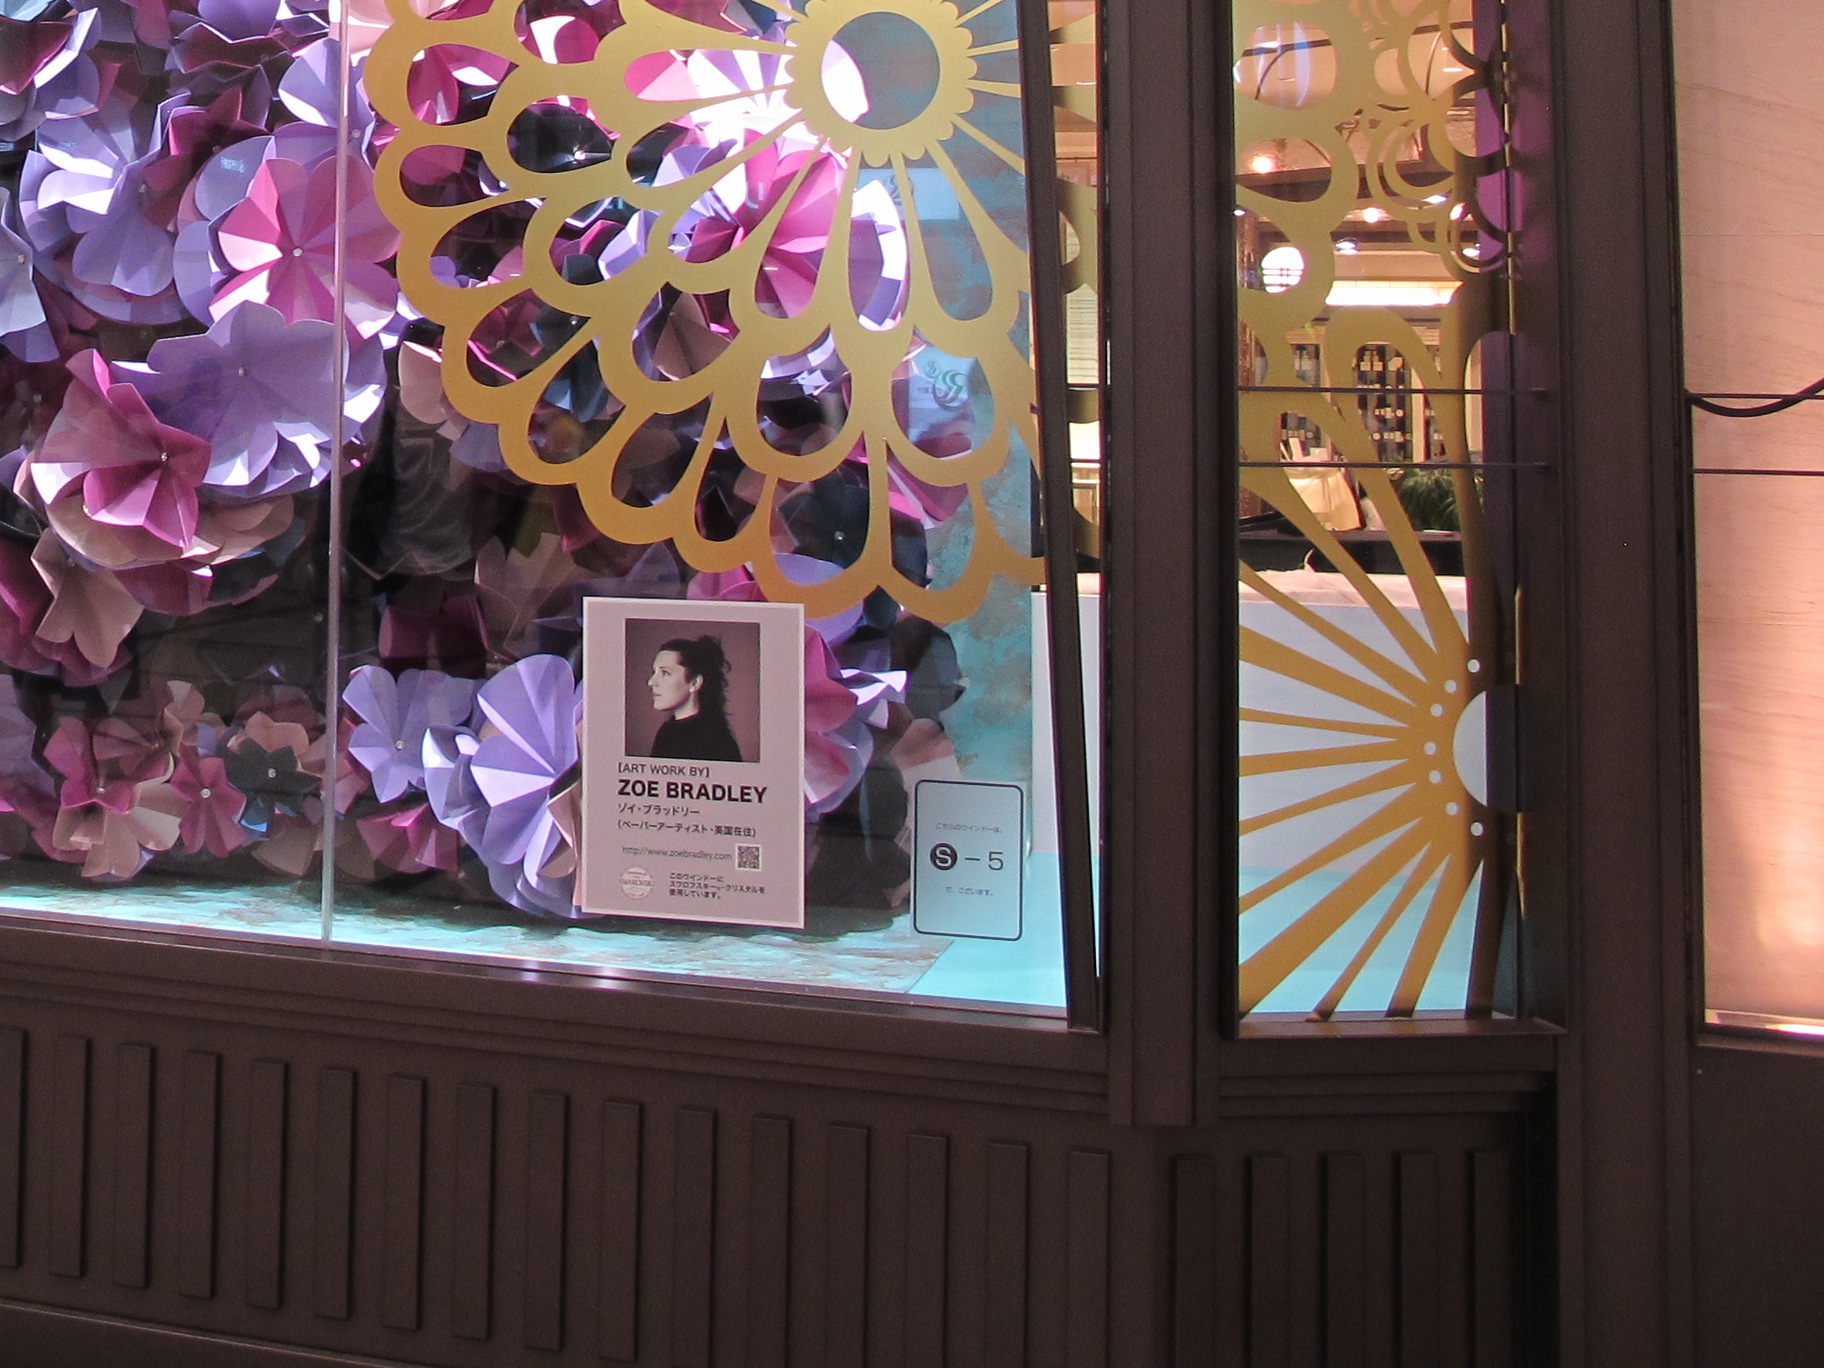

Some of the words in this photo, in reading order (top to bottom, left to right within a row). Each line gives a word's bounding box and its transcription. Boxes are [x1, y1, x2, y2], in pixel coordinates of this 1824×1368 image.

[650, 764, 686, 776] WORK
[618, 779, 659, 797] ZOE
[666, 781, 768, 803] BRADLEY
